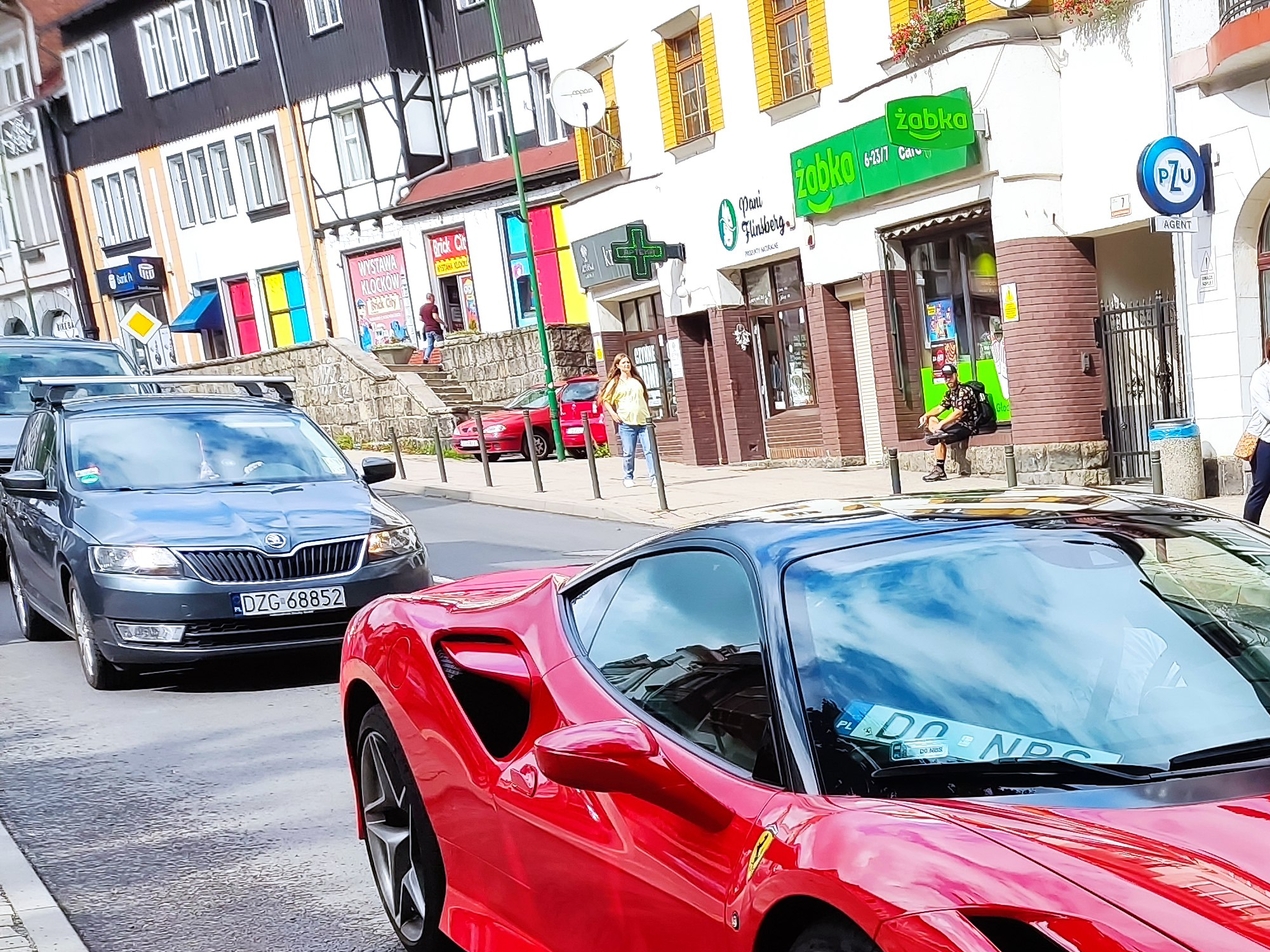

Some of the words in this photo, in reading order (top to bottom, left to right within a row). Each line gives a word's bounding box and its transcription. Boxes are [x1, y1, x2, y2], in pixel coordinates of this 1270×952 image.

[894, 107, 968, 131] żabka
[795, 147, 856, 198] żabka
[1158, 160, 1192, 192] PZU
[739, 189, 763, 218] Pani
[1163, 219, 1192, 230] AGENT
[358, 253, 398, 277] WYSTAWA
[242, 594, 280, 613] DZG
[287, 588, 343, 609] 68852
[836, 719, 853, 731] PL
